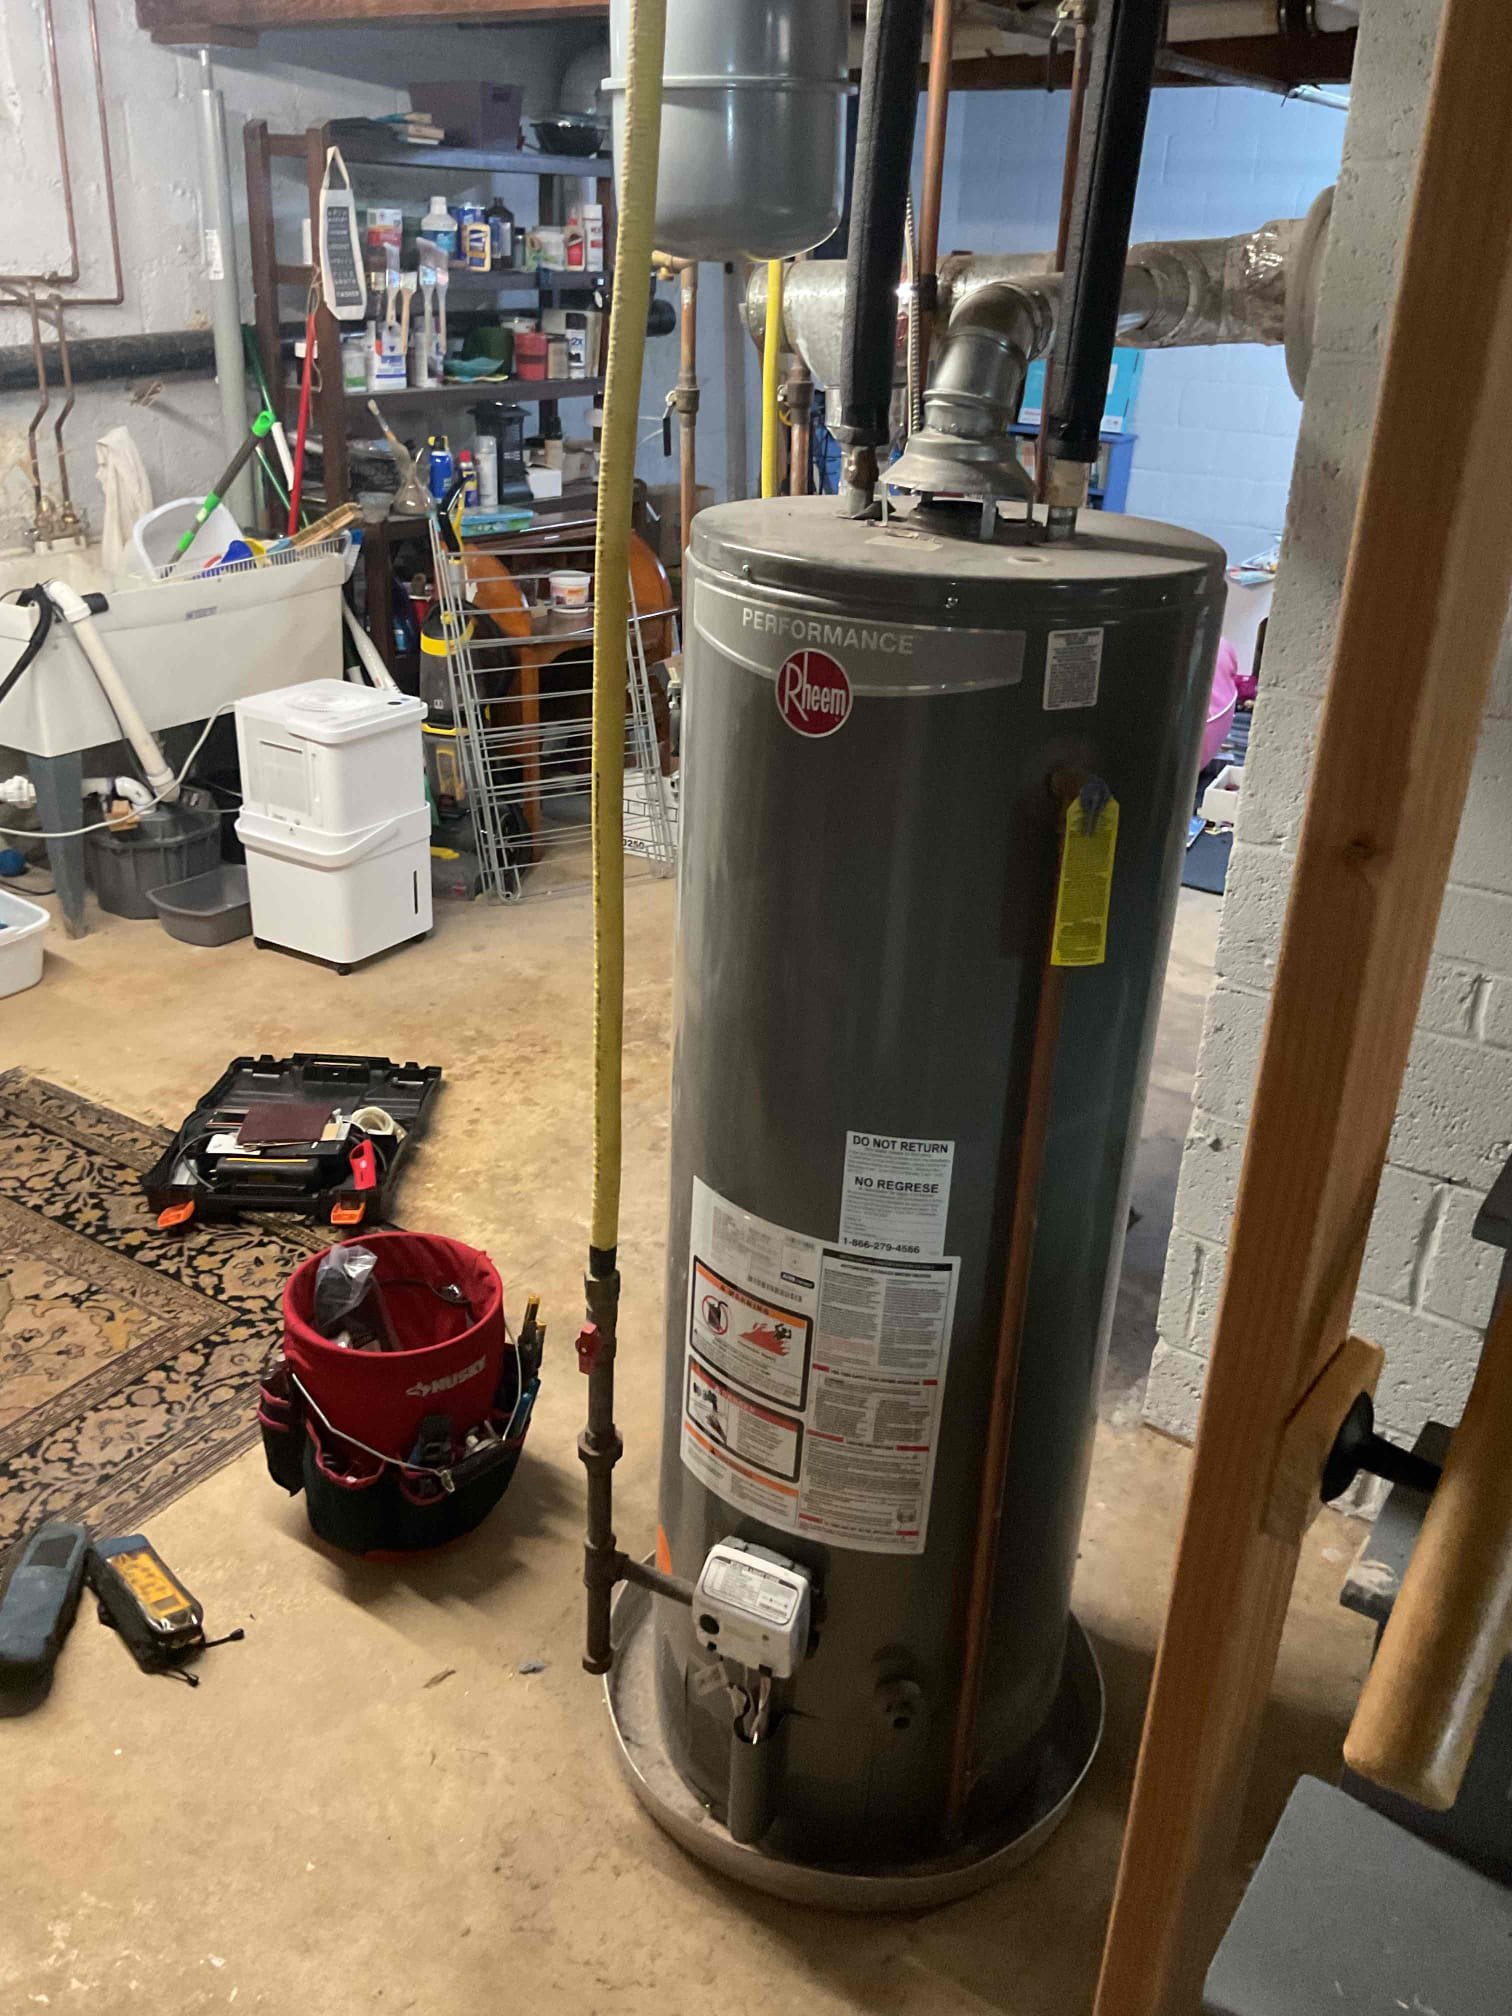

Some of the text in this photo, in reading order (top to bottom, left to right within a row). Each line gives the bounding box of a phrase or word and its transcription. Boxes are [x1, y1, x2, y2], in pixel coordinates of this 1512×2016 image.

[742, 607, 914, 655] PERFORMANCE
[784, 652, 846, 722] Rheem
[852, 1135, 949, 1153] DO NOT RETURN
[854, 1176, 940, 1194] NO REGRESE
